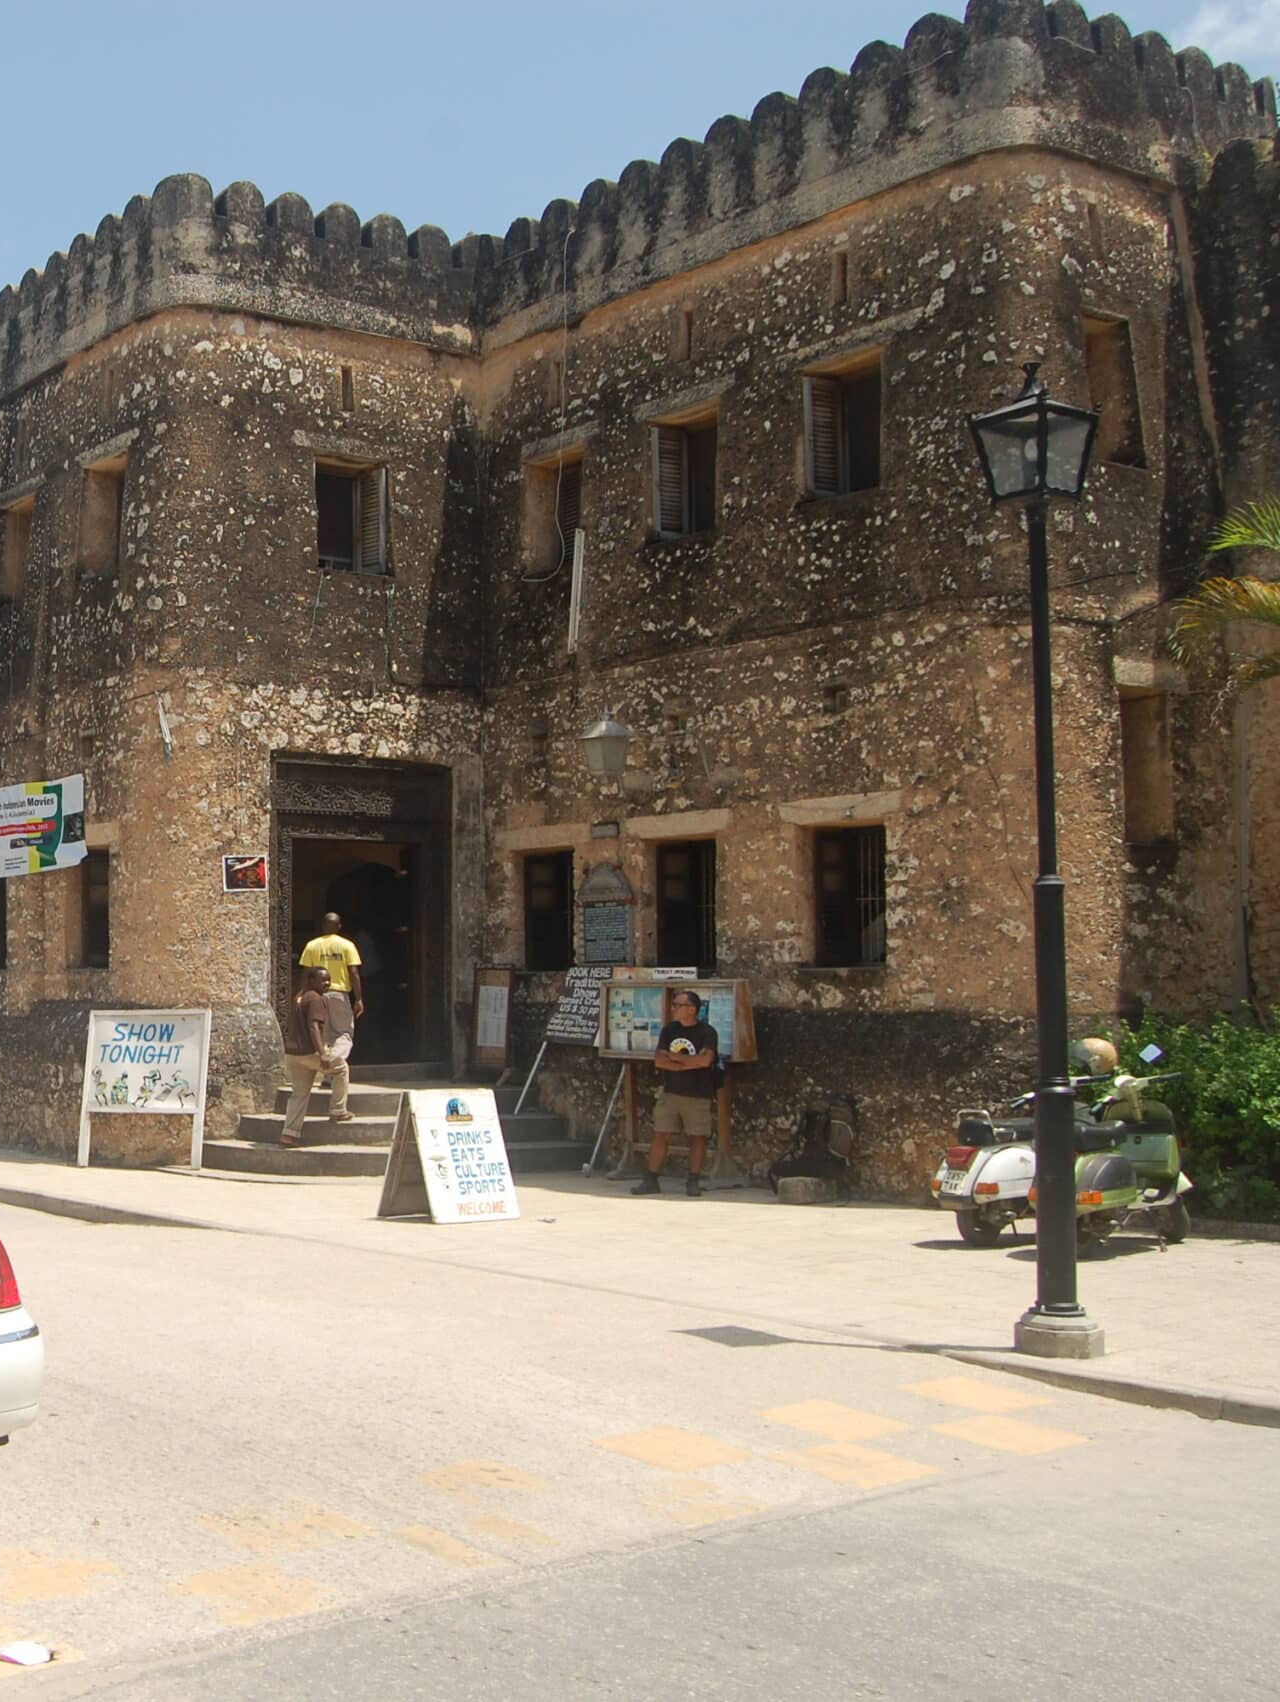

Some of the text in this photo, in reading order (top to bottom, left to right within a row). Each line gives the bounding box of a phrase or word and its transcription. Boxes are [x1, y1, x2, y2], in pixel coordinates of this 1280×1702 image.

[27, 796, 55, 807] Movies
[567, 967, 611, 977] BOOK HERE
[573, 988, 599, 998] Dhow
[112, 1023, 175, 1042] SHOW
[100, 1044, 184, 1064] TONIGHT
[447, 1130, 492, 1146] DRINKS
[450, 1147, 485, 1162] EATS
[454, 1162, 506, 1178] CULTURE
[458, 1178, 505, 1195] SPORTS
[456, 1200, 507, 1215] WELCOME
